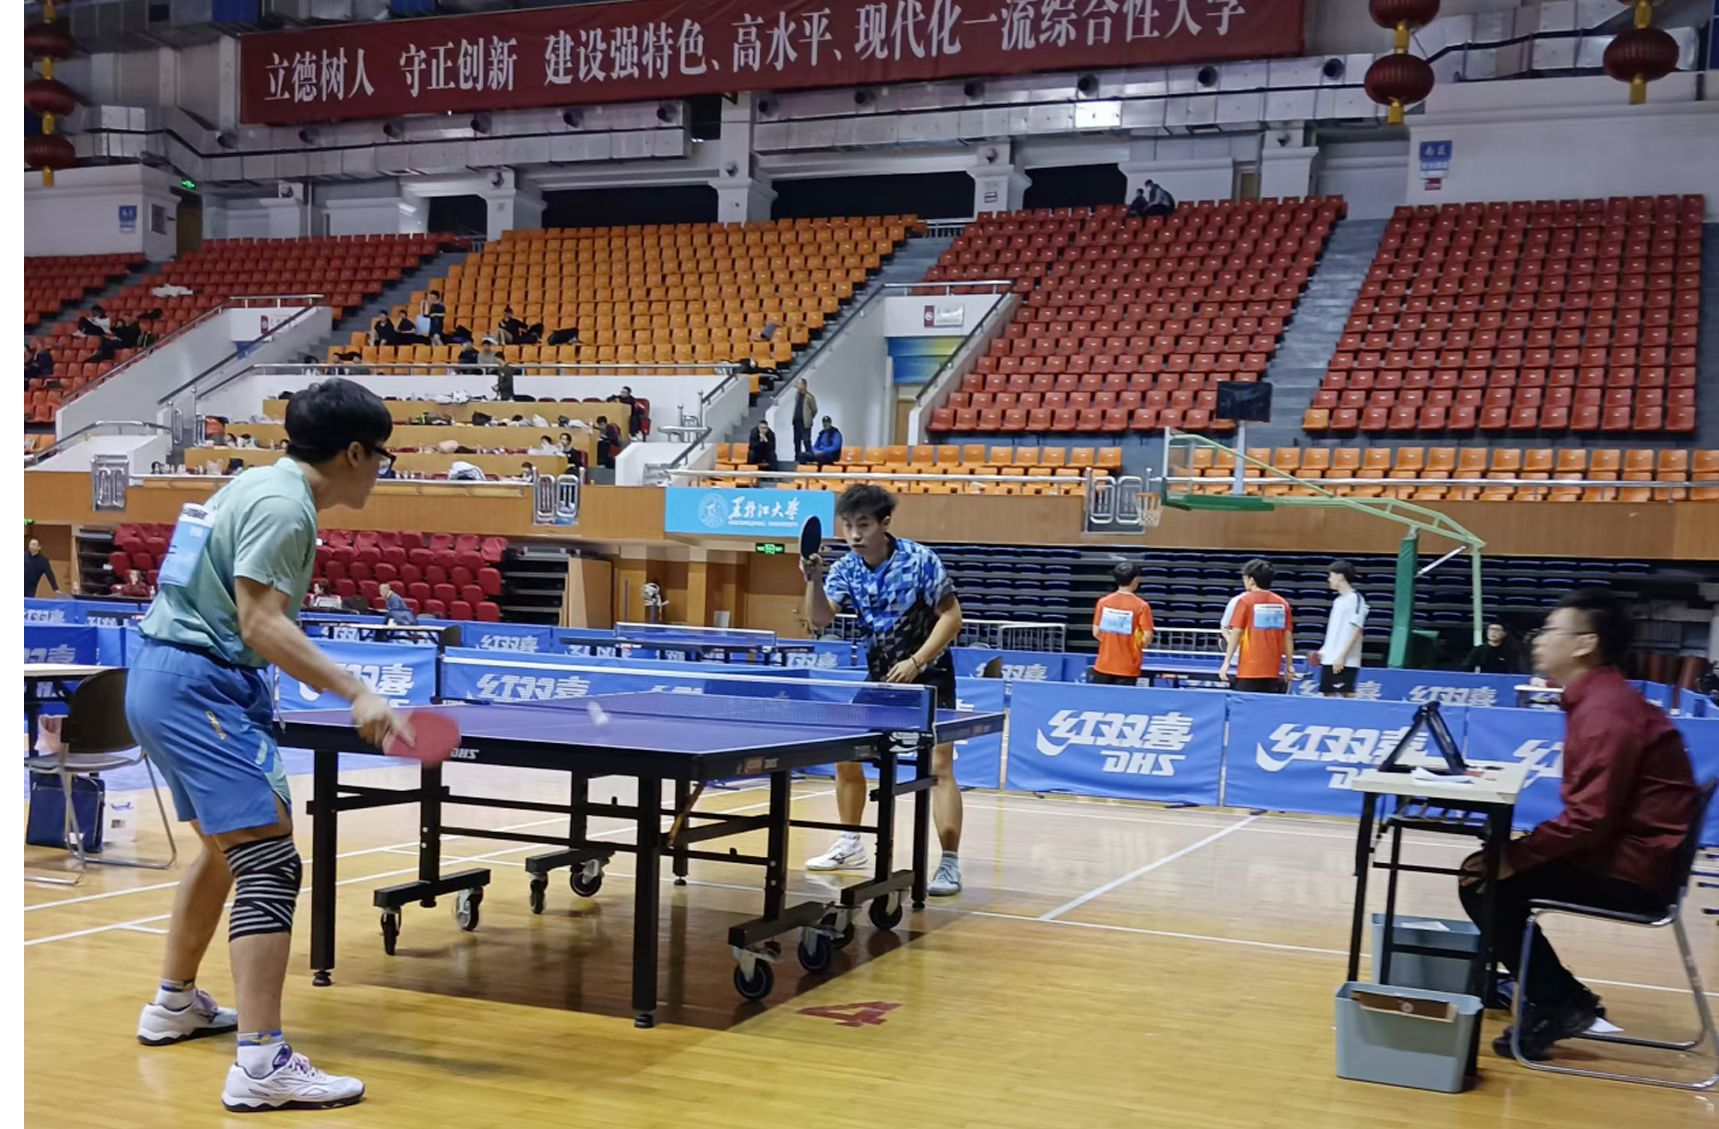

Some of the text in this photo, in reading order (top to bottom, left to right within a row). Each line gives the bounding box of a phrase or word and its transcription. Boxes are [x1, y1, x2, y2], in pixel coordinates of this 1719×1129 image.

[264, 49, 374, 103] 立德树人
[399, 36, 518, 97] 守正创新
[467, 674, 591, 700] 红双喜
[1036, 709, 1194, 756] 红双喜
[1256, 723, 1429, 772] 红双喜
[1100, 750, 1186, 776] DHS
